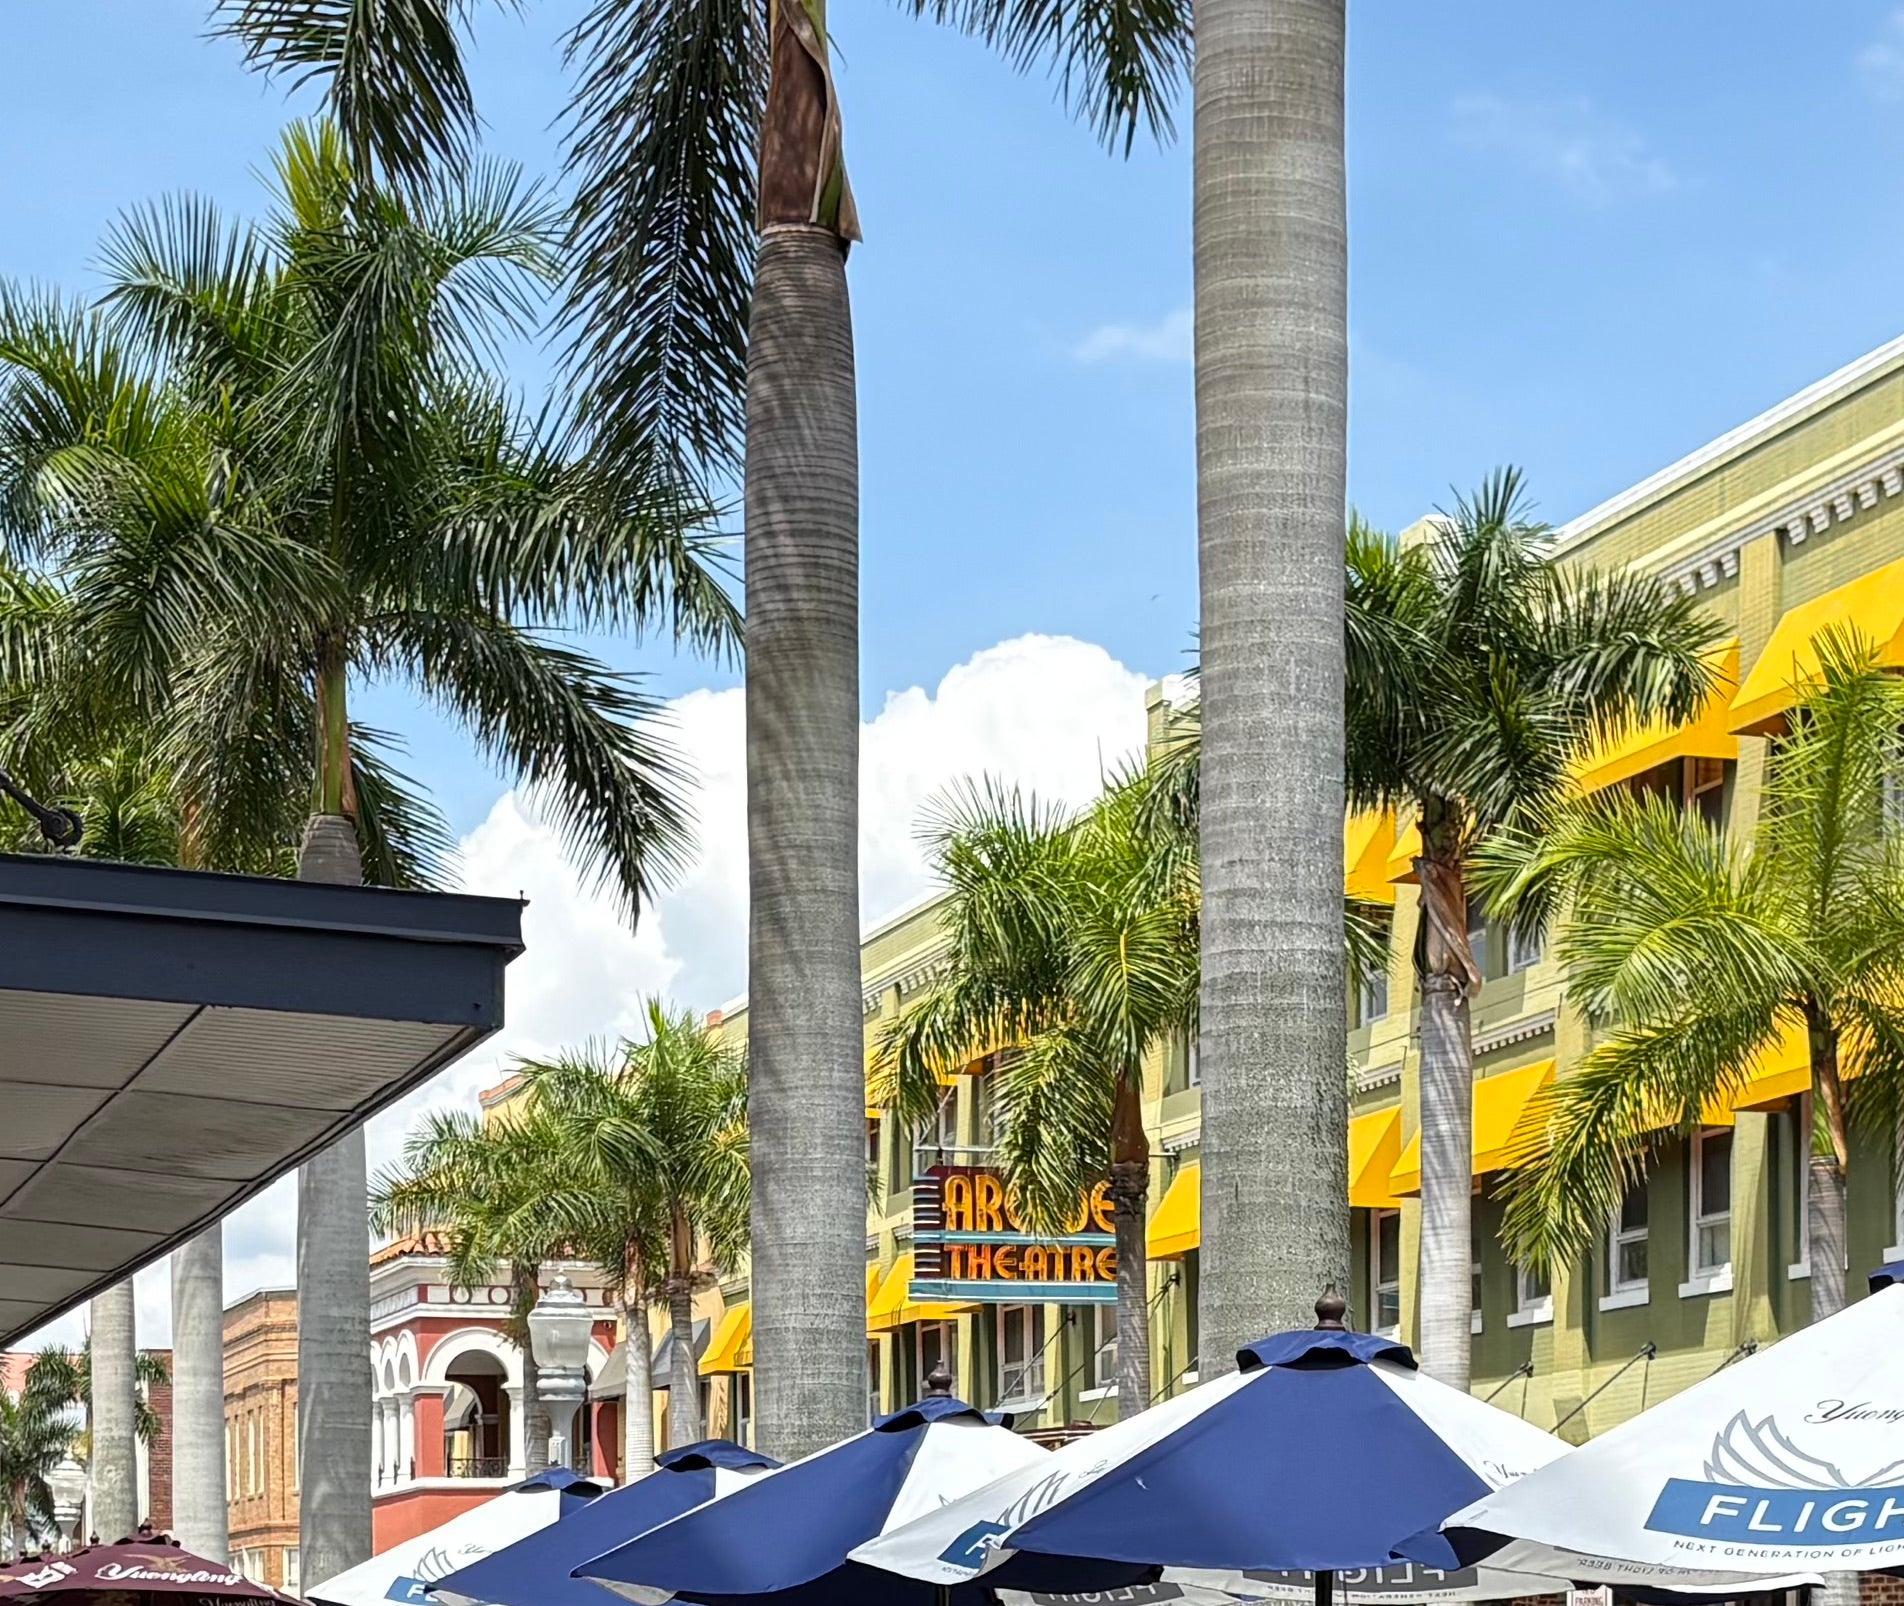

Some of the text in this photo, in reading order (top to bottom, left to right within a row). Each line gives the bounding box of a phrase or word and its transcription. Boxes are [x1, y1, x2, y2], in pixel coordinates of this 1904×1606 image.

[942, 1174, 1116, 1233] ARCDE
[944, 1244, 1118, 1282] THEATRE
[1674, 1540, 1716, 1554] NEXT
[1724, 1547, 1834, 1559] GENERATION
[1840, 1547, 1863, 1558] OF
